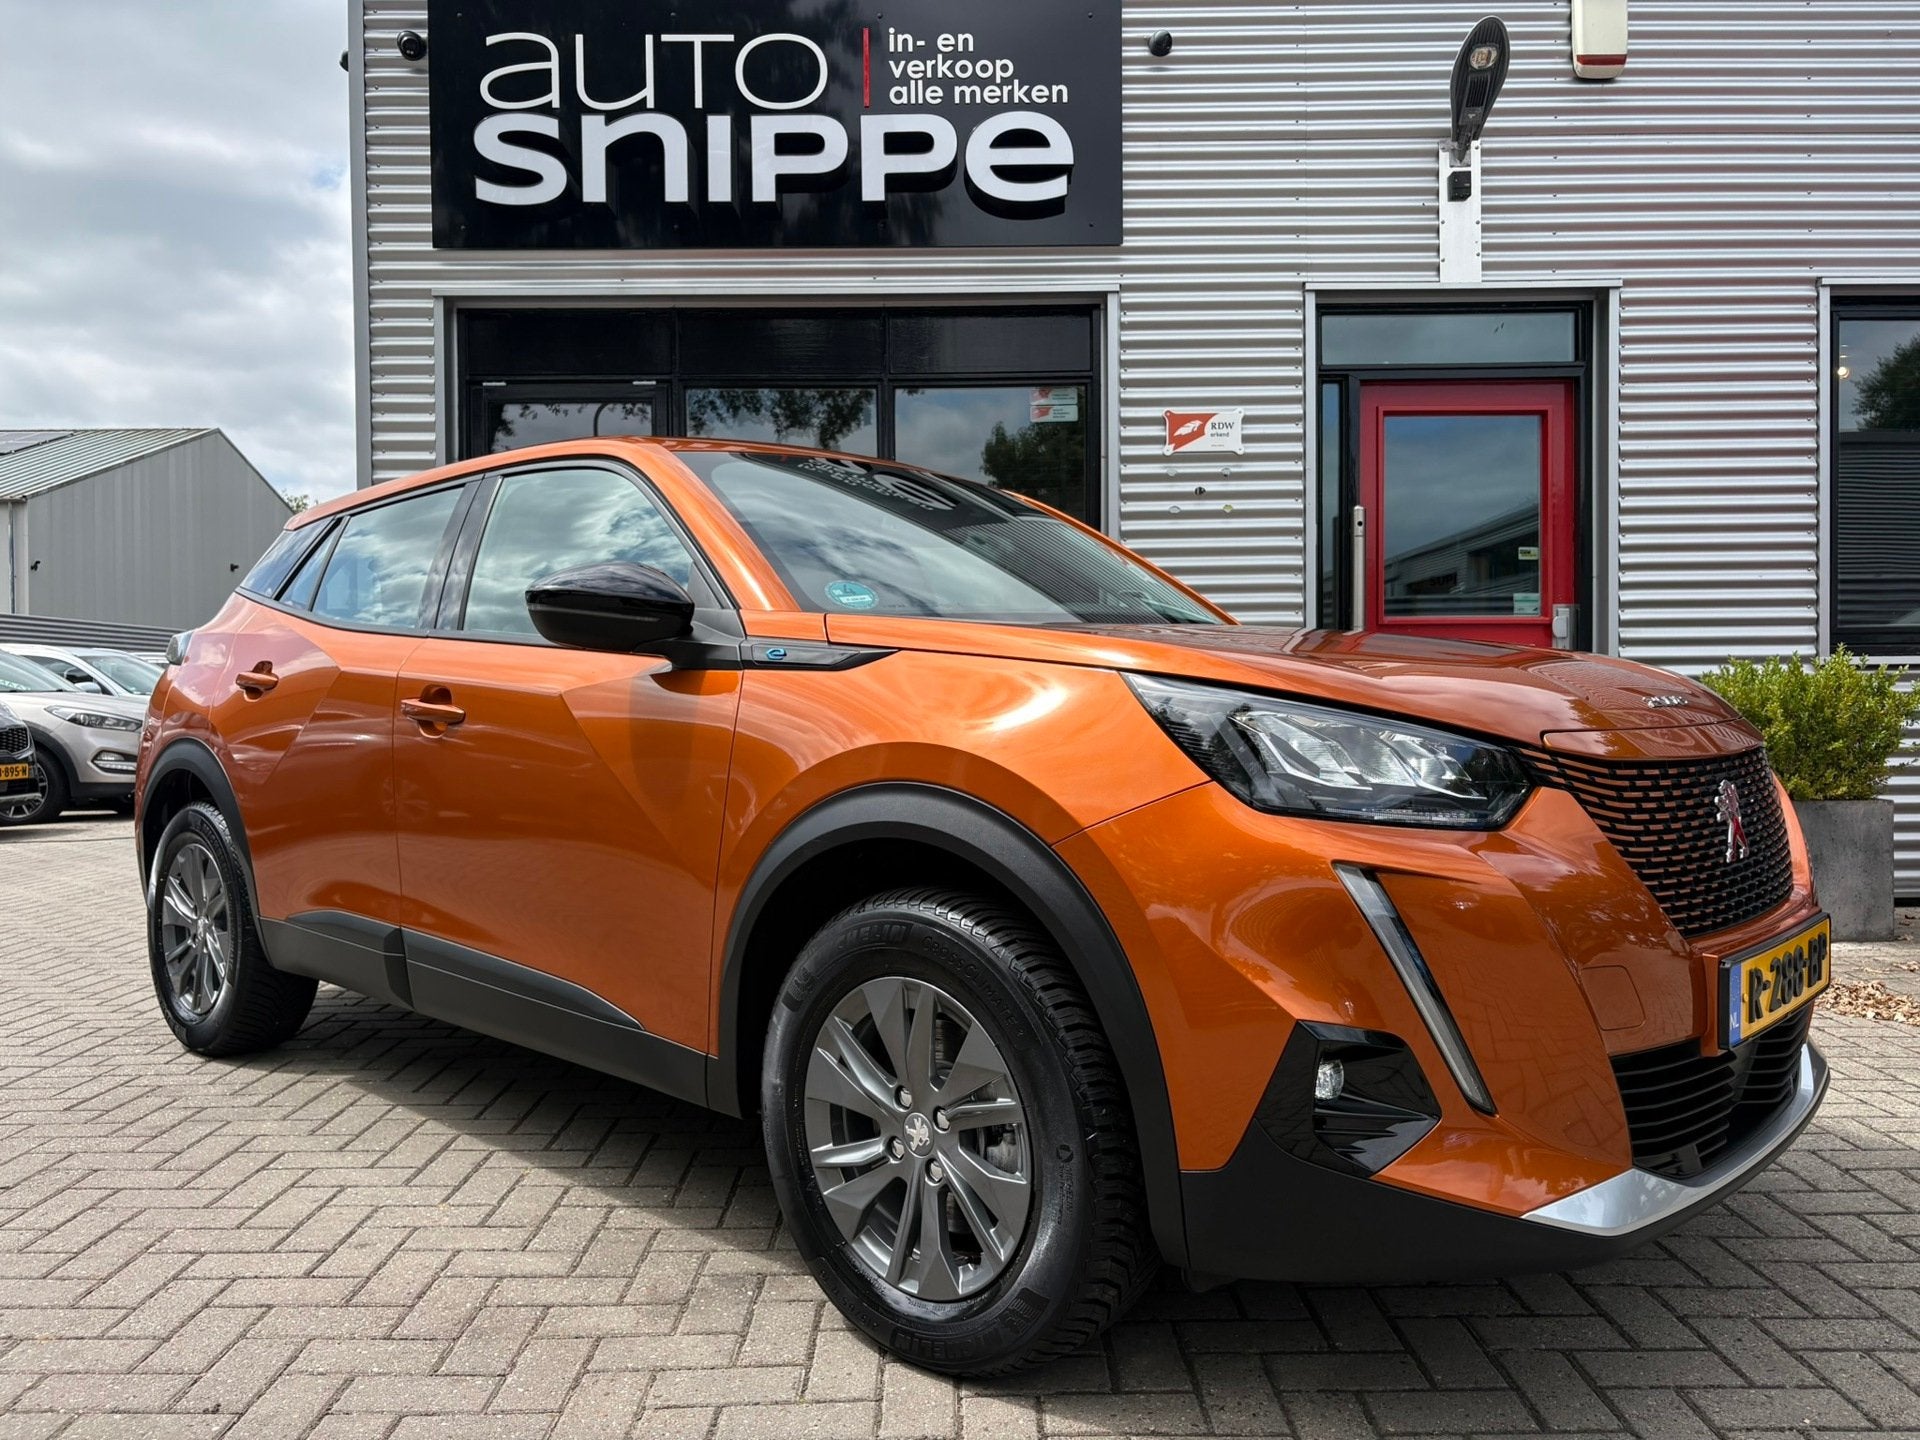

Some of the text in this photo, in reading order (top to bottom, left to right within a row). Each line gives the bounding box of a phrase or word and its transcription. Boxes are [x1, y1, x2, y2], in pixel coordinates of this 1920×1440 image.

[888, 26, 974, 53] in- en
[888, 58, 1014, 84] verkoop
[888, 78, 1069, 105] alle merken
[1210, 421, 1235, 431] RDW
